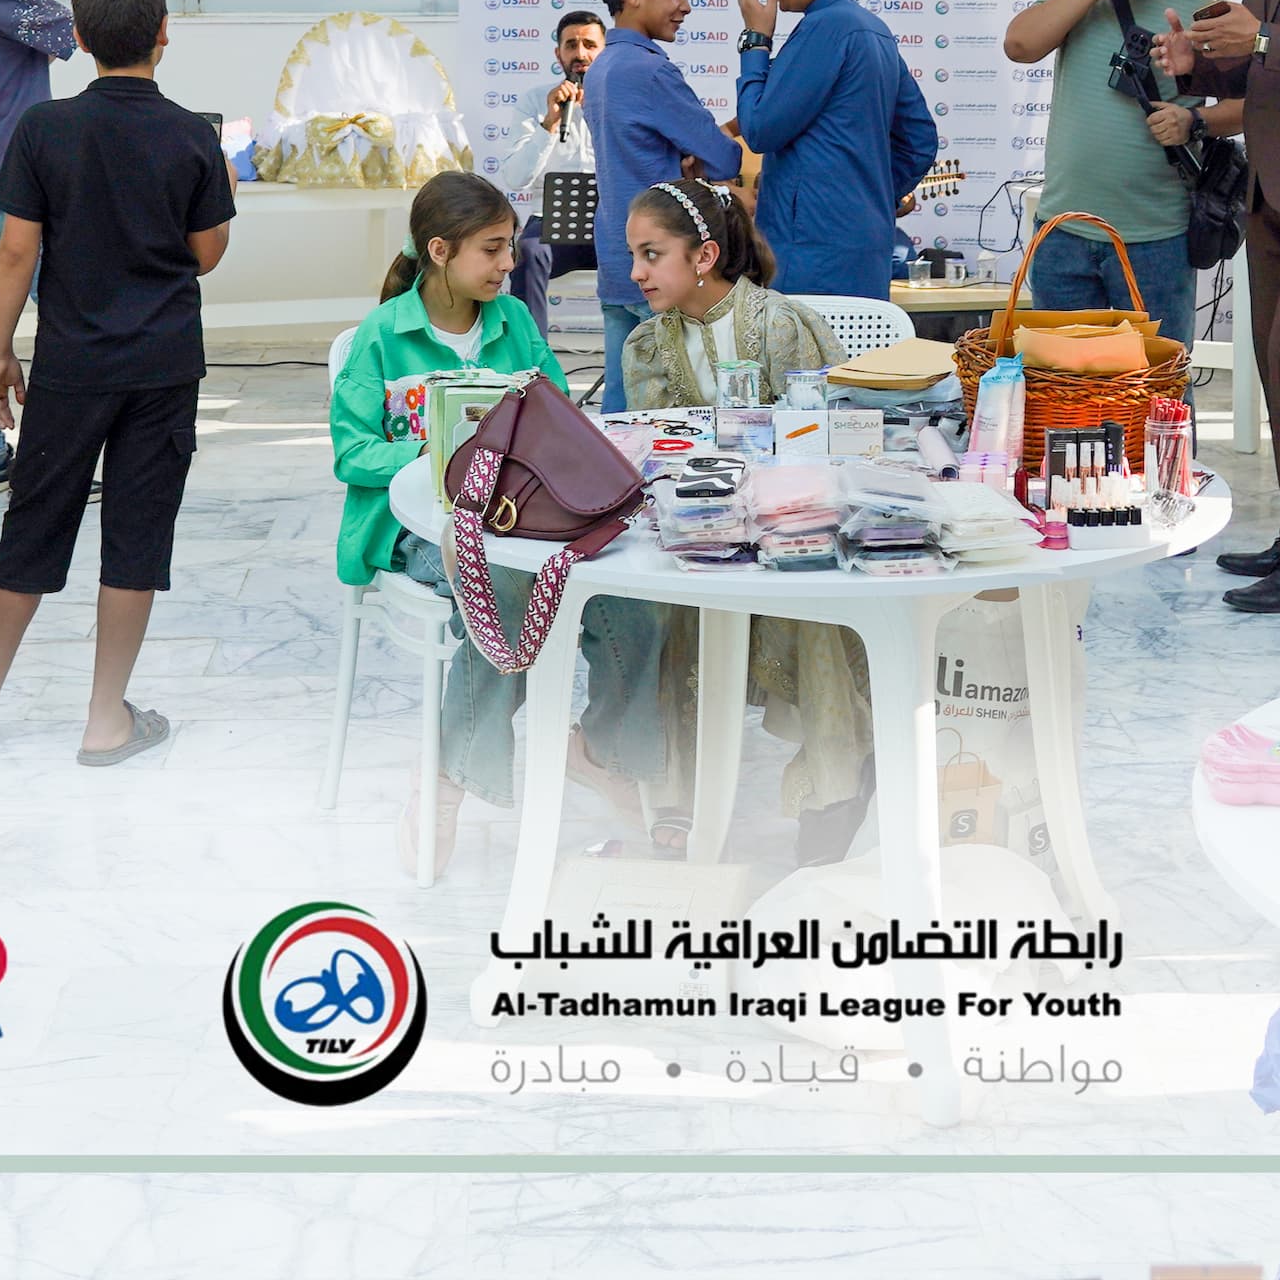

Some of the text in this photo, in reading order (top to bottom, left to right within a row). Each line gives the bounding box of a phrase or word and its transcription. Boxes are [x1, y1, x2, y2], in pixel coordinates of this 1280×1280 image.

[884, 1, 923, 10] USAID
[502, 28, 539, 38] USAID
[690, 31, 728, 41] USAID
[502, 61, 539, 71] USAID
[690, 64, 728, 74] USAID
[1026, 69, 1053, 78] GCER
[975, 707, 1008, 720] SHEIN
